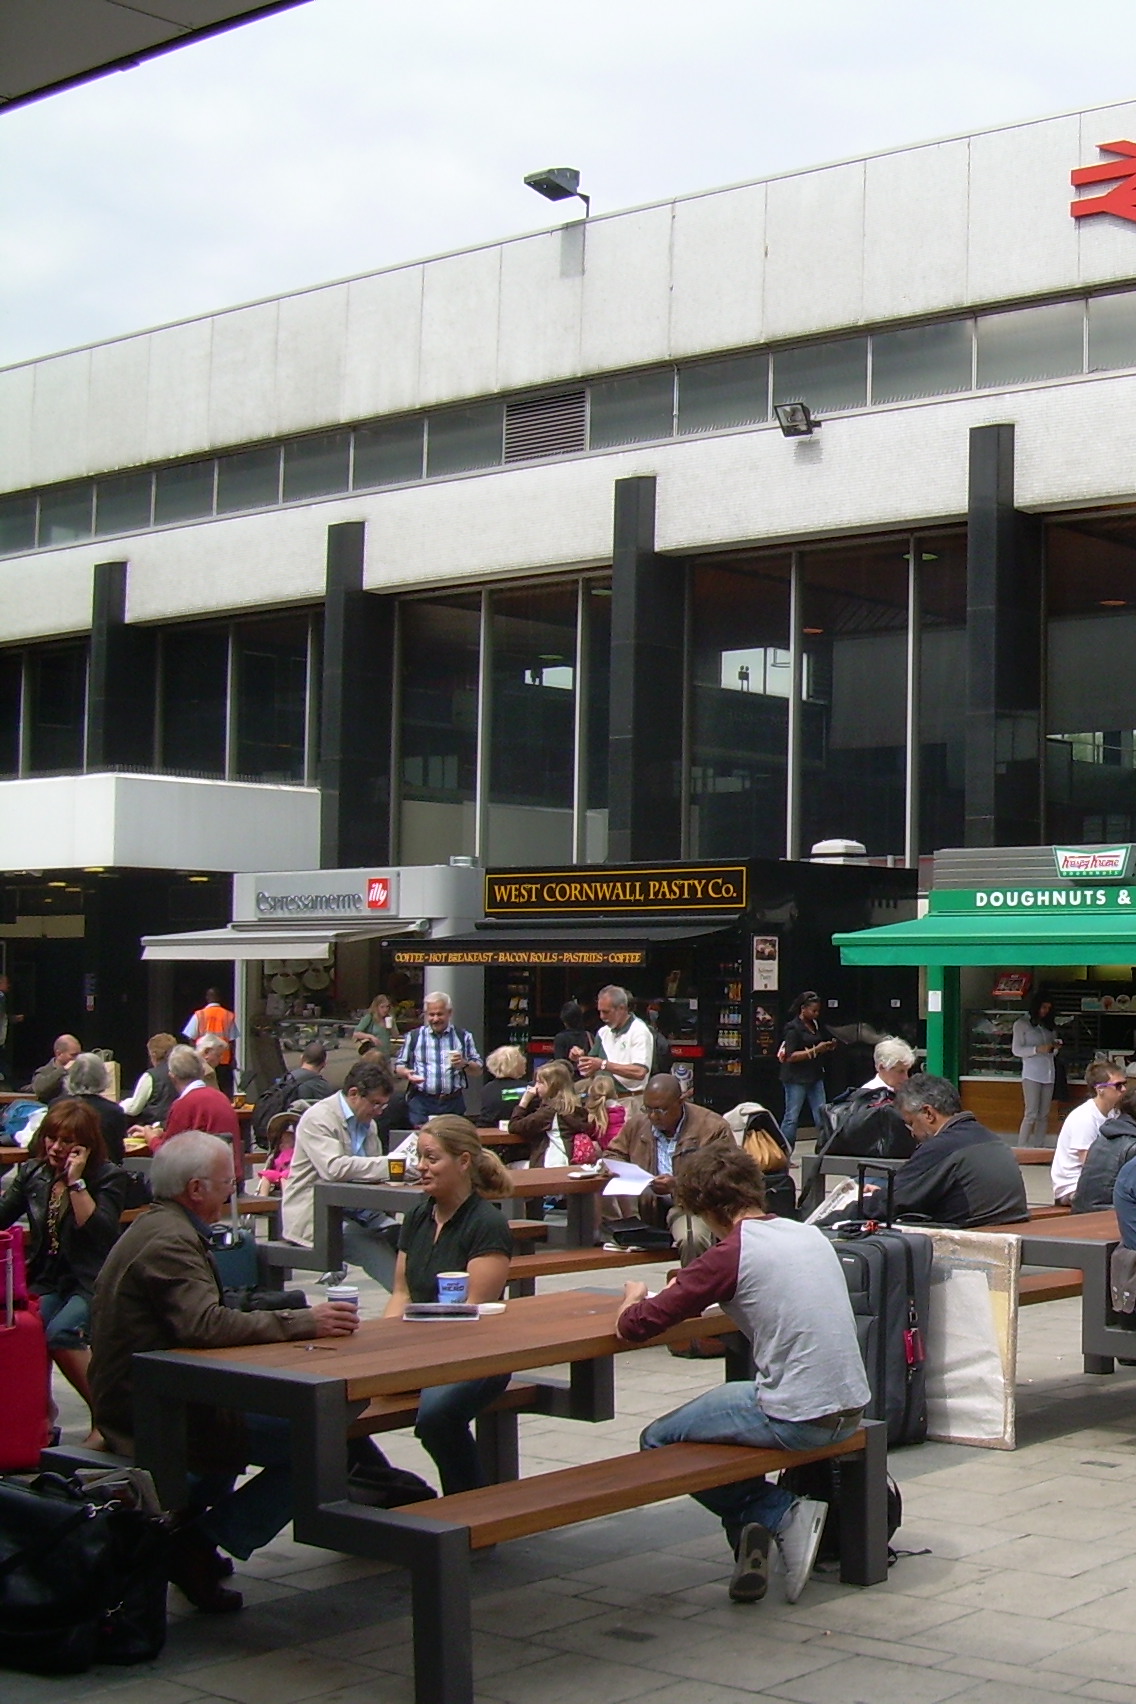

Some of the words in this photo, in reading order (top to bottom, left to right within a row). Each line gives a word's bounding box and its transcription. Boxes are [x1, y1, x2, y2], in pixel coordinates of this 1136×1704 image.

[369, 883, 388, 906] illy
[493, 883, 541, 903] WEST
[543, 881, 645, 903] CORNWALL
[648, 879, 708, 900] PASTY
[975, 889, 1106, 907] DOUGHNUTS
[1117, 889, 1131, 905] &
